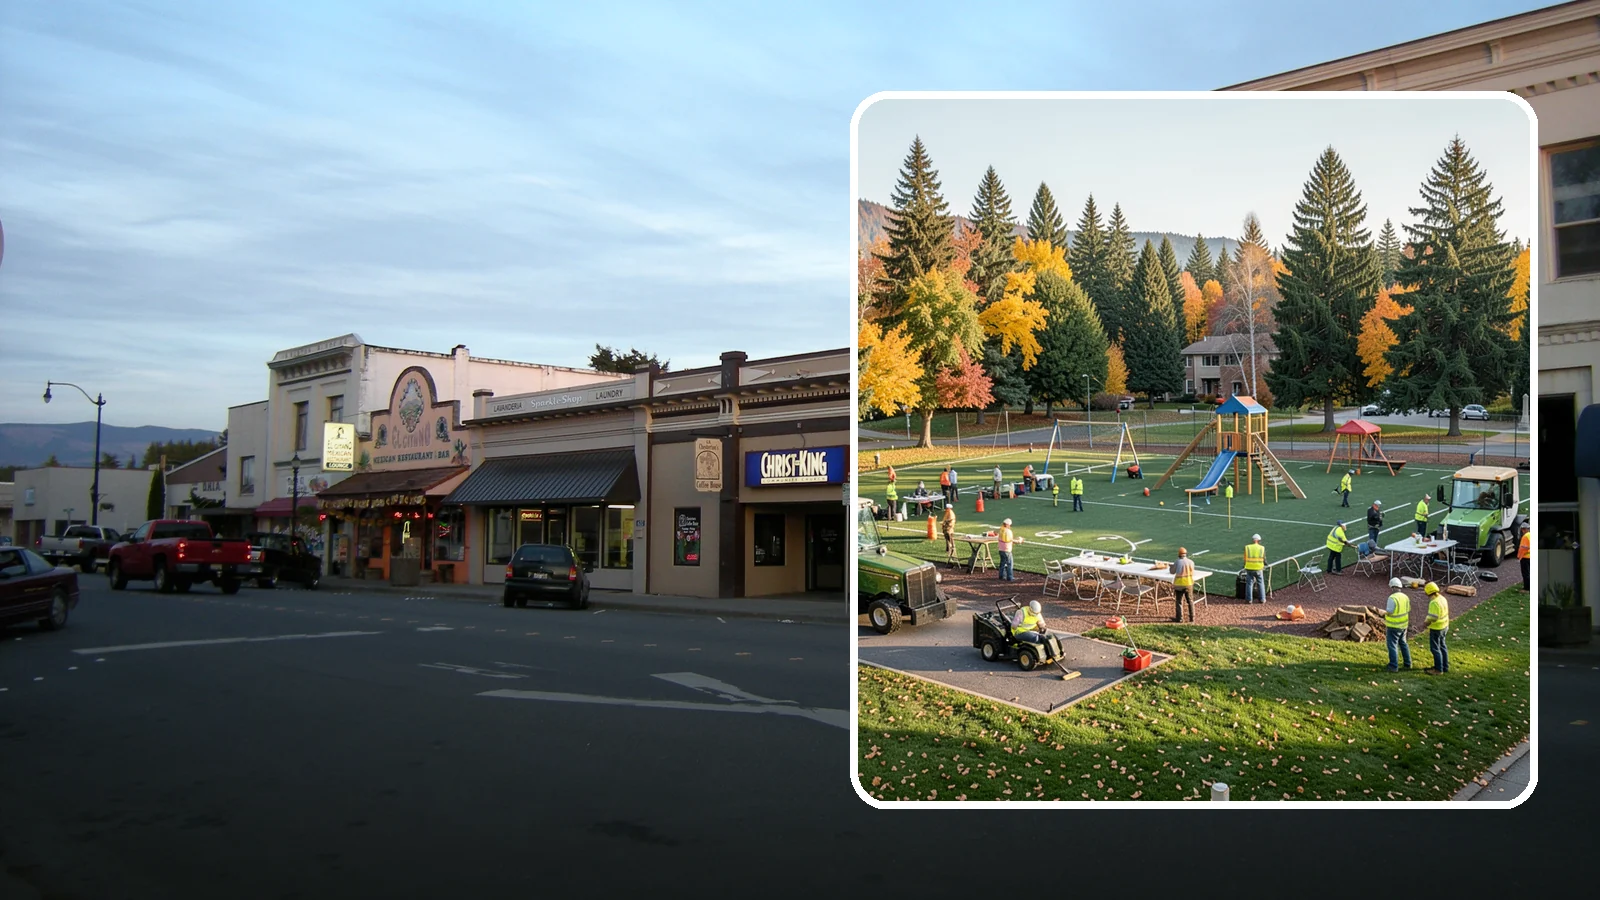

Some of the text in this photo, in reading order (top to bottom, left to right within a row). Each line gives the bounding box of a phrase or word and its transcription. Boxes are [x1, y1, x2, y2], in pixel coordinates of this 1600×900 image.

[562, 394, 583, 406] Shop
[595, 389, 624, 400] LAUNDRY
[493, 402, 522, 413] LAVANDERIA
[373, 454, 396, 465] MEXICAN
[397, 451, 433, 463] RESTAURANT
[438, 449, 450, 459] BAR
